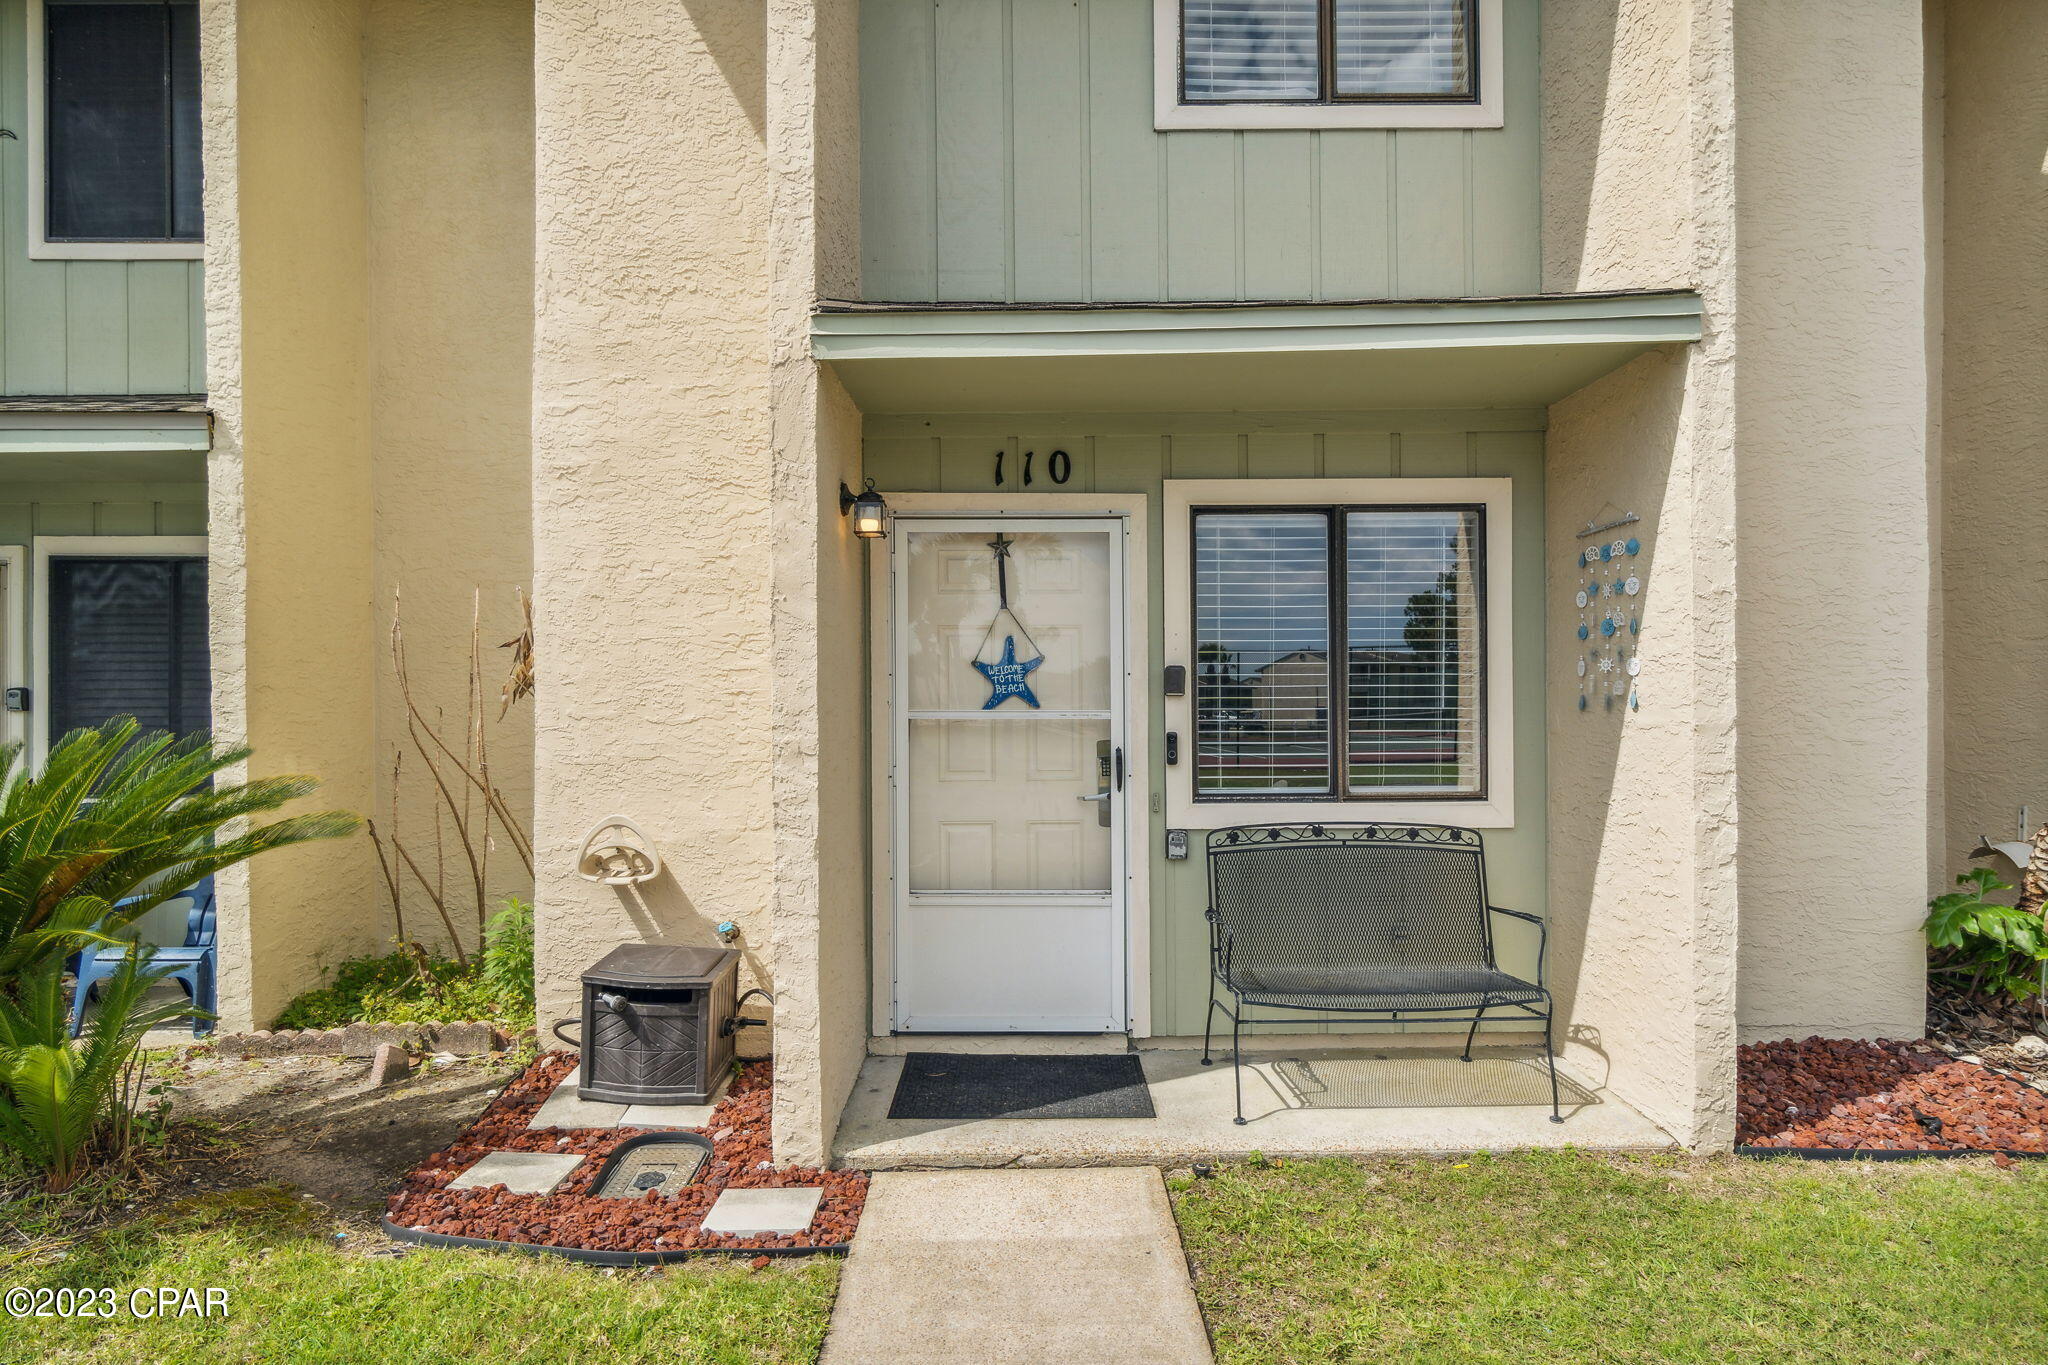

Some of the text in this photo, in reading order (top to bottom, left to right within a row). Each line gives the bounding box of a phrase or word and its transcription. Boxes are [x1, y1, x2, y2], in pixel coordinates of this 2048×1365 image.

[995, 450, 1071, 487] 110
[988, 665, 1025, 675] WELCOME
[991, 674, 1024, 684] TO THE
[995, 683, 1025, 694] BEACH
